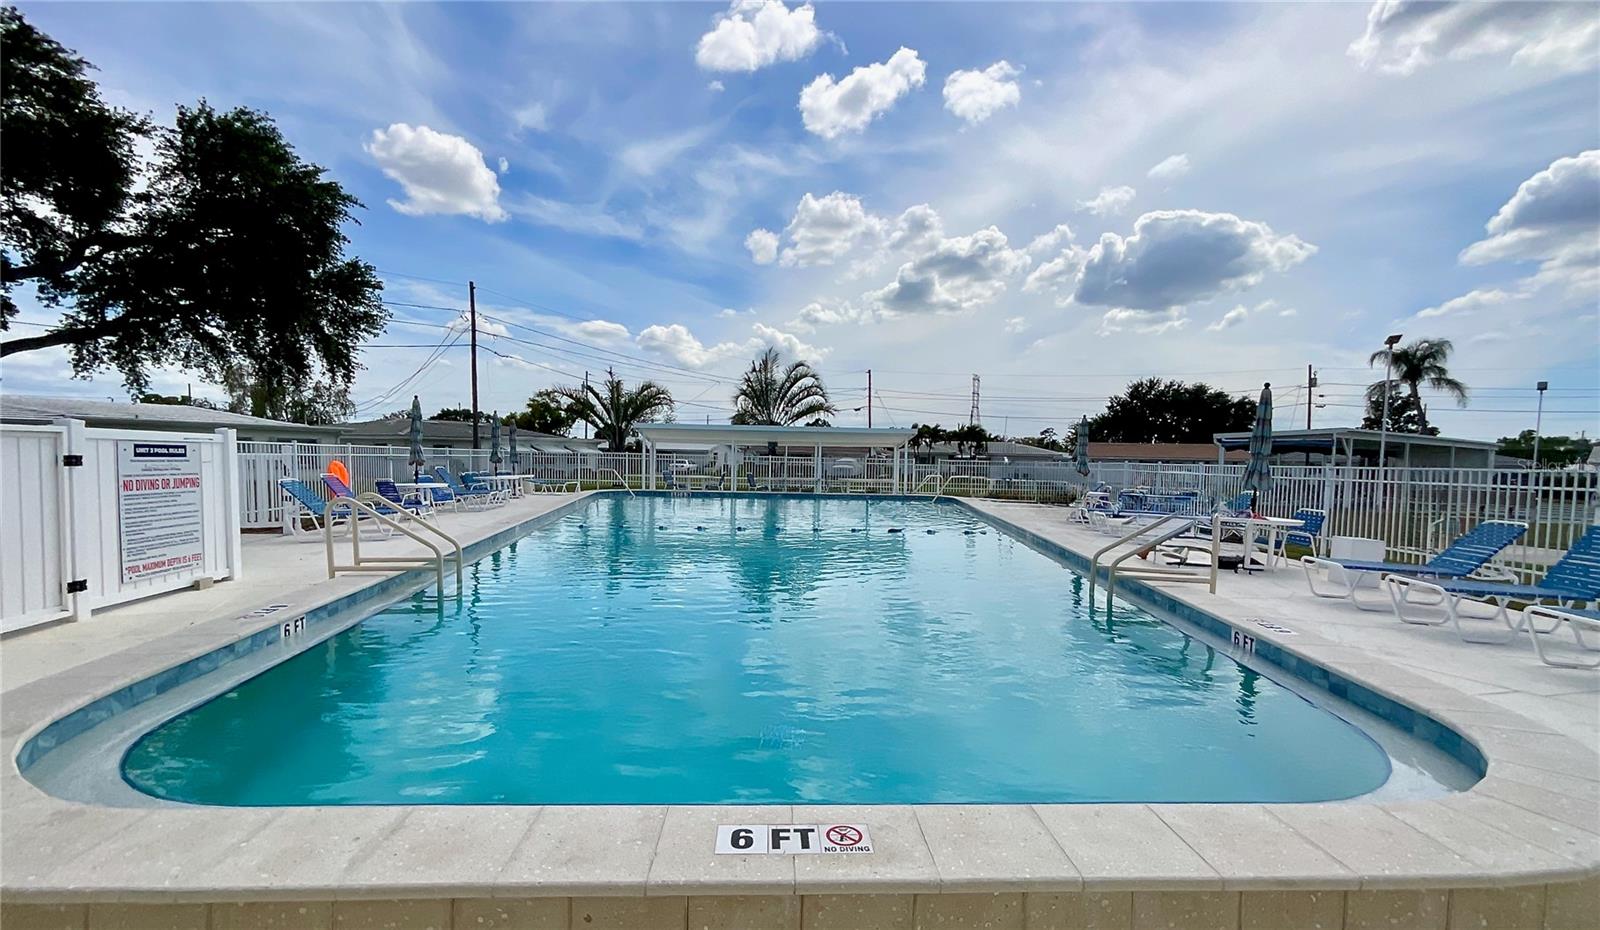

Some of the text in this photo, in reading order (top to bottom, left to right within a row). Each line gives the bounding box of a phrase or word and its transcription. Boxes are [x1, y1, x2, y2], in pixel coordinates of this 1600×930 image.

[123, 477, 200, 491] NO DIVING OR JUMPING
[142, 560, 167, 572] MAXIMUM
[167, 557, 181, 567] DEPTH
[182, 555, 187, 564] IS
[191, 553, 202, 561] FEET
[284, 616, 305, 637] 6 FT
[1234, 631, 1254, 652] 6 FT
[730, 828, 815, 850] 6 FT
